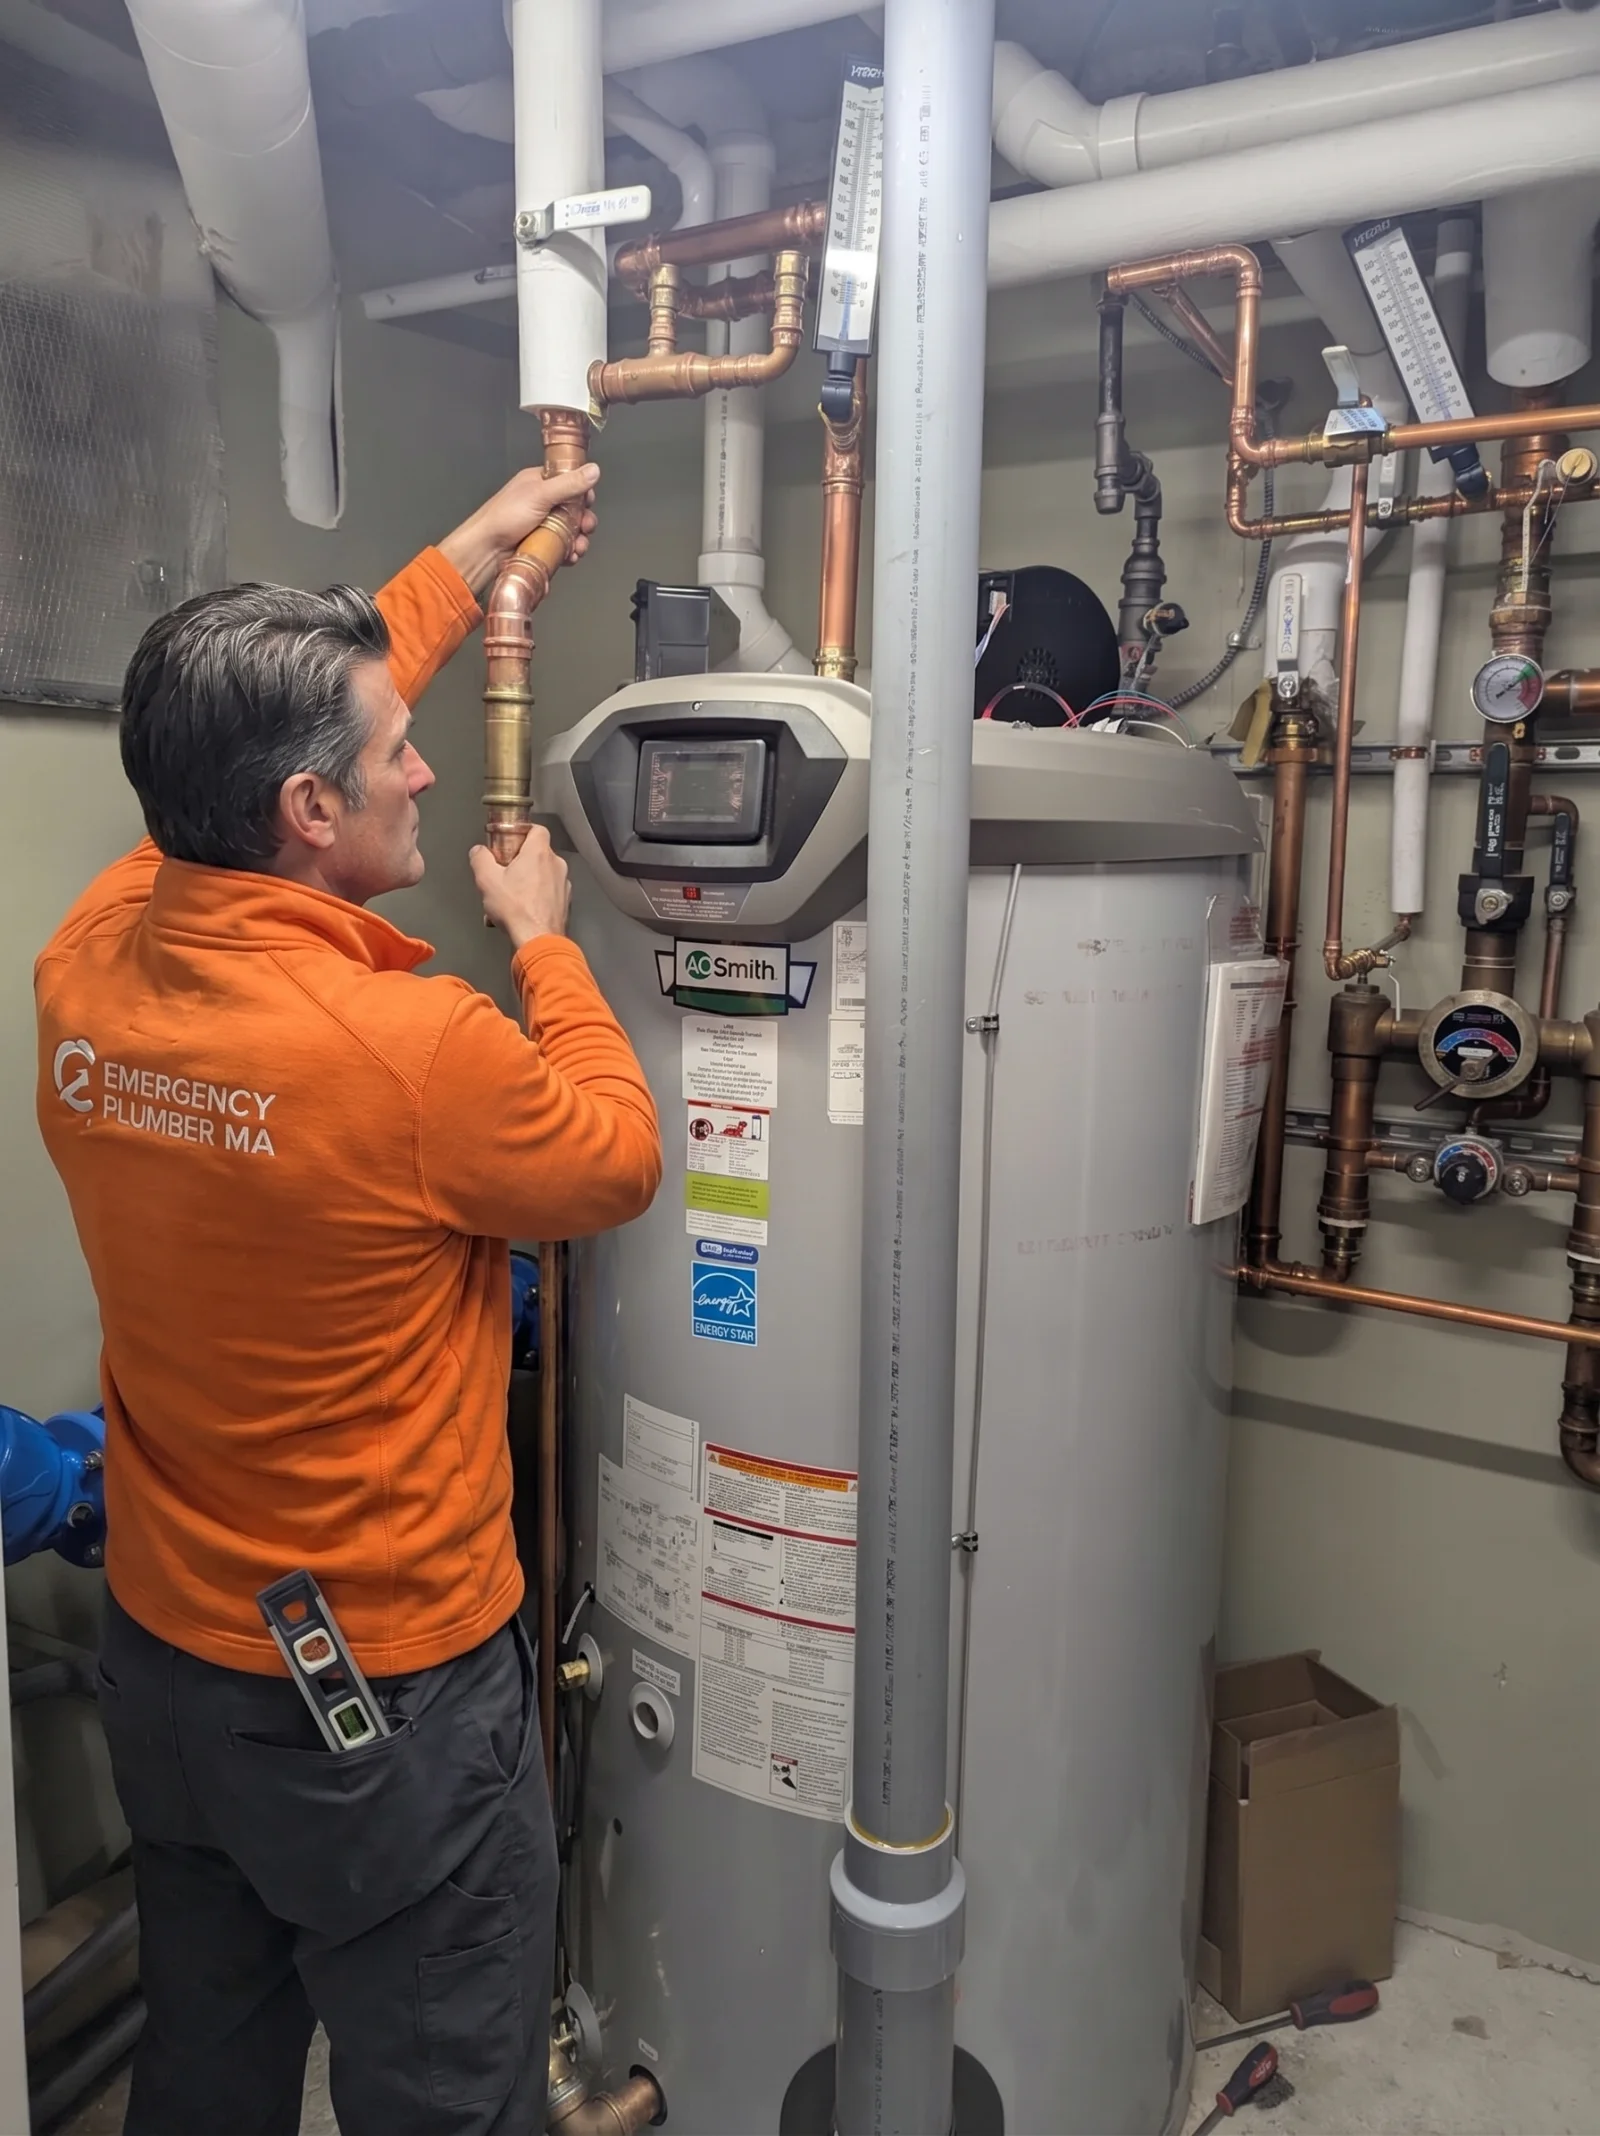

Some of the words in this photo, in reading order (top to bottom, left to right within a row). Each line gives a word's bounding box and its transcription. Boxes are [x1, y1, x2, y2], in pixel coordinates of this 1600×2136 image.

[103, 1062, 276, 1121] EMERGENCY
[103, 1094, 215, 1147] PLUMBER
[225, 1123, 275, 1157] MA
[695, 1293, 736, 1315] energy
[695, 1322, 730, 1338] ENERGY
[730, 1328, 754, 1342] STAR
